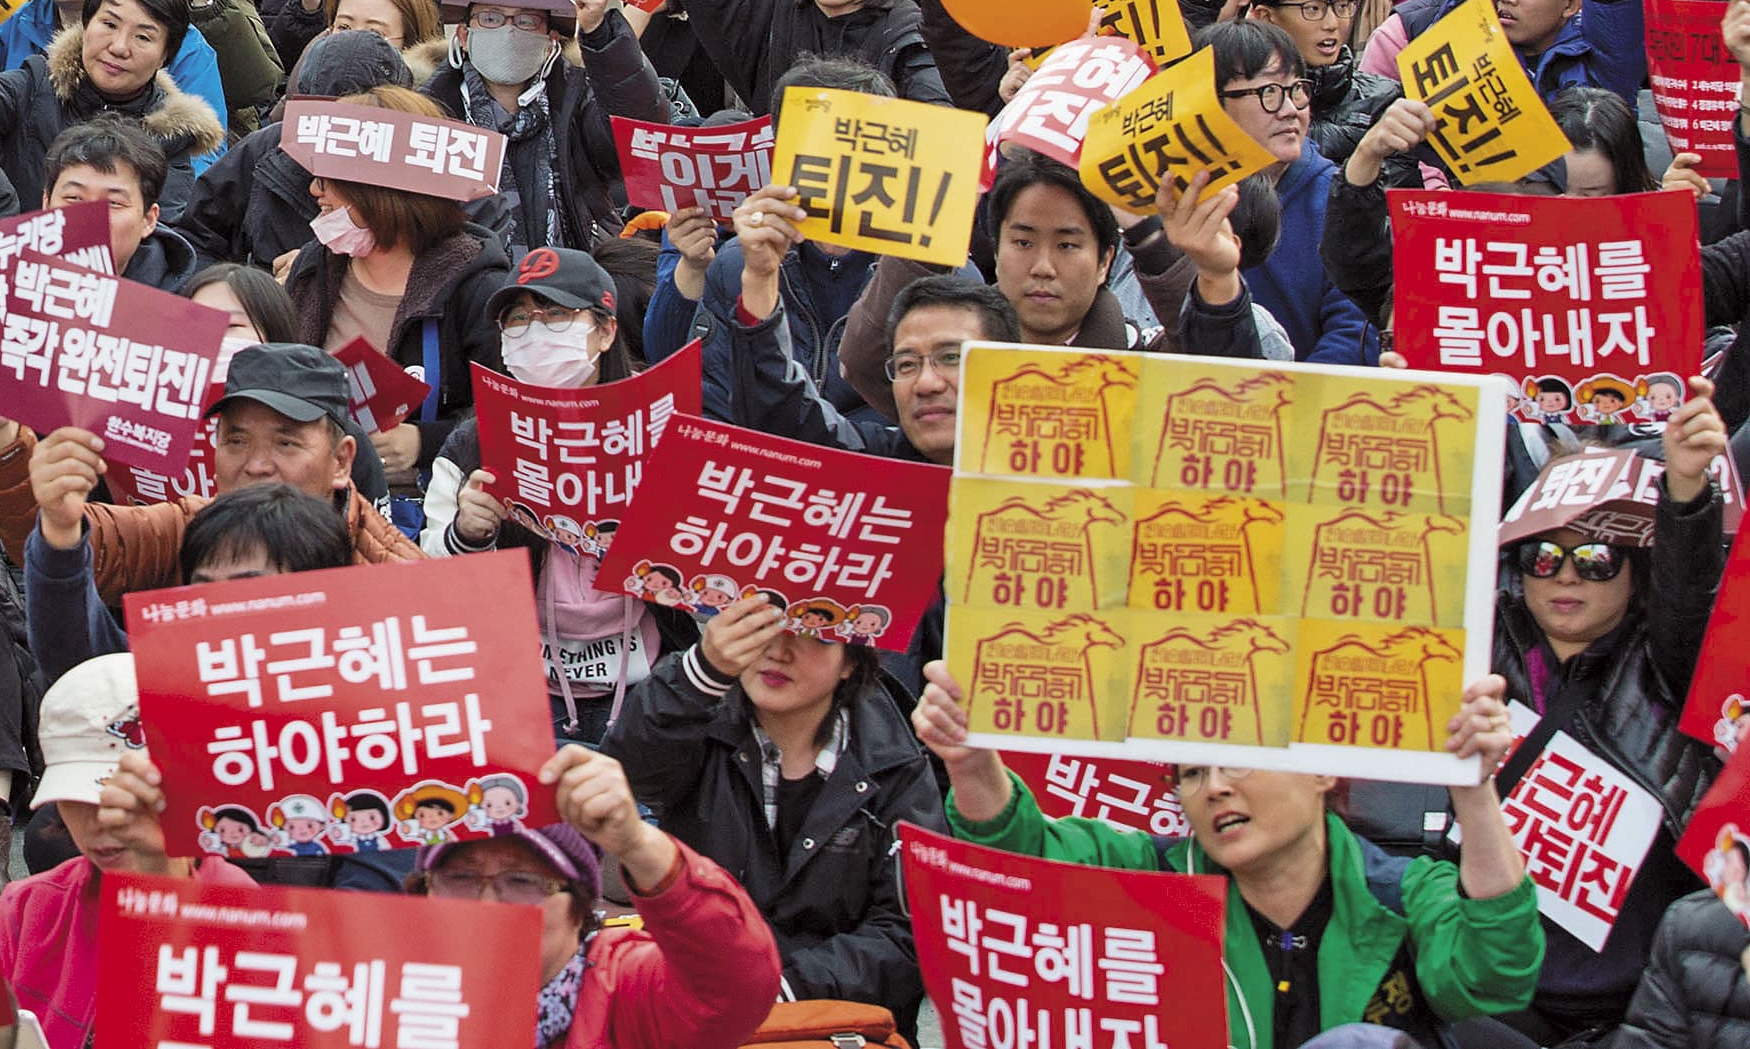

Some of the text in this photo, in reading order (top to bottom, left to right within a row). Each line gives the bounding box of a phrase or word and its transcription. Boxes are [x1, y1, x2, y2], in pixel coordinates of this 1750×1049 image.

[1122, 93, 1175, 139] 박근혜
[1476, 53, 1521, 127] 박근혜
[296, 116, 485, 180] 박근혜 퇴진
[834, 117, 918, 158] 박근혜
[790, 156, 952, 250] 퇴진!
[1402, 201, 1531, 224] 나눔문화 www.nanum.com
[15, 261, 117, 328] 박근혜
[1435, 238, 1651, 301] 박근혜를
[1, 316, 210, 420] 즉각 완전퇴진!
[1433, 305, 1655, 369] 몰아내자
[677, 424, 822, 469] 나눔문화 www.nanum.com
[696, 461, 914, 544] 박근혜는
[670, 517, 894, 598] 하야하라
[141, 589, 325, 623] 나눔문화 www.nanum.com
[196, 613, 477, 708] 박근혜는
[207, 693, 491, 791] 하야하라
[939, 894, 1165, 1005] 박근혜를
[156, 944, 470, 1049] 박근혜를
